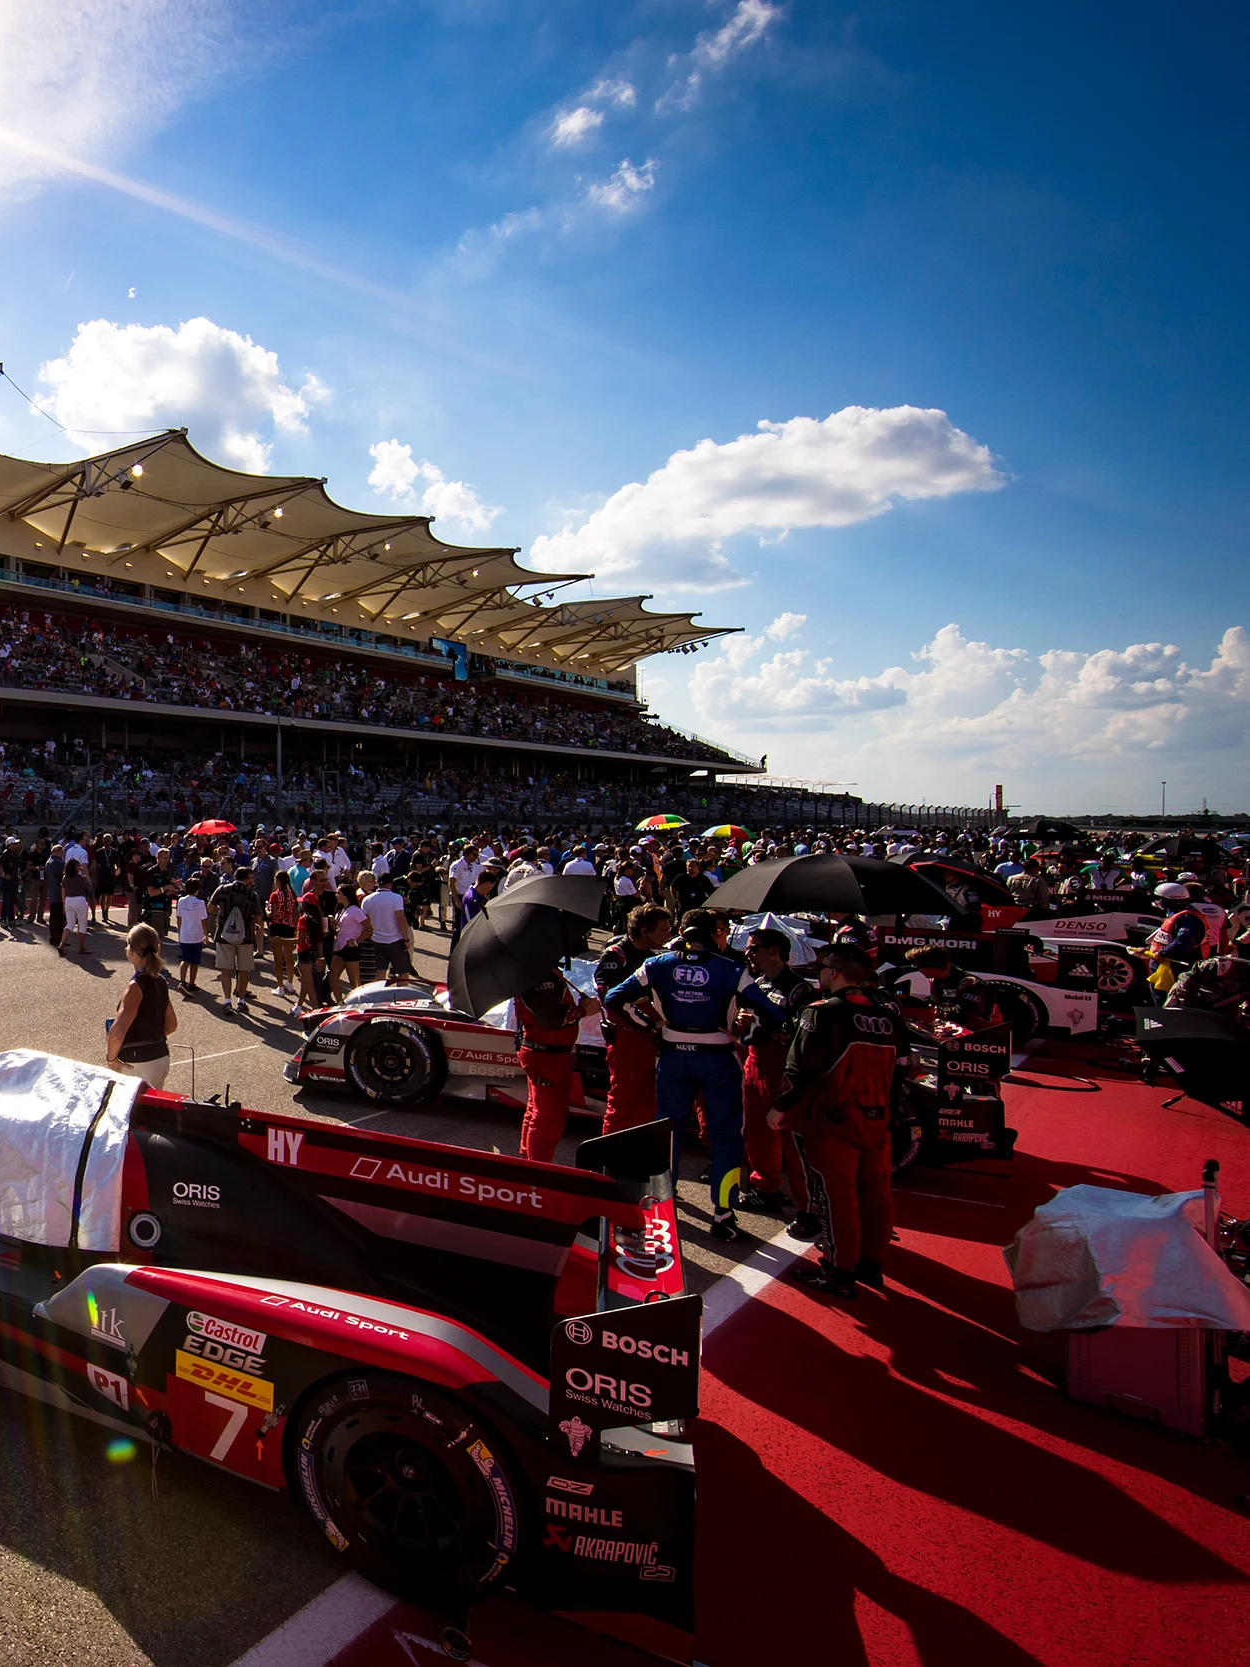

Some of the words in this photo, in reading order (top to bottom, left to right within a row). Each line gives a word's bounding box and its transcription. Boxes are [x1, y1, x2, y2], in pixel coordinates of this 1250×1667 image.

[987, 909, 1000, 918] HY
[1092, 894, 1124, 902] MORI
[1054, 920, 1107, 931] DENSO
[884, 935, 926, 946] DMG
[929, 937, 977, 950] MORI
[316, 1036, 340, 1047] ORIS
[964, 1042, 1006, 1054] BOSCH
[464, 1051, 493, 1061] Audi
[496, 1053, 520, 1066] Spo
[468, 1064, 515, 1079] BOSCH
[946, 1060, 989, 1074] ORIS
[938, 1117, 974, 1128] MAHLE
[267, 1126, 304, 1164] HY
[172, 1181, 221, 1201] ORIS
[385, 1163, 449, 1190] Audi
[459, 1176, 543, 1208] Sport
[172, 1197, 191, 1206] Swiss
[192, 1199, 220, 1209] Watches
[204, 1319, 260, 1350] Castrol
[290, 1301, 340, 1321] Audi
[344, 1314, 409, 1340] Sport
[182, 1335, 267, 1376] EDGE
[602, 1330, 689, 1367] BOSCH
[94, 1370, 123, 1406] P1
[190, 1362, 257, 1398] DHL
[565, 1366, 652, 1408] ORIS
[565, 1388, 598, 1406] Swiss
[600, 1398, 652, 1421] Watches
[204, 1391, 248, 1462] 7
[300, 1453, 325, 1521] MICHELIN
[492, 1476, 515, 1550] MICHELIN
[545, 1496, 623, 1528] MAHLE
